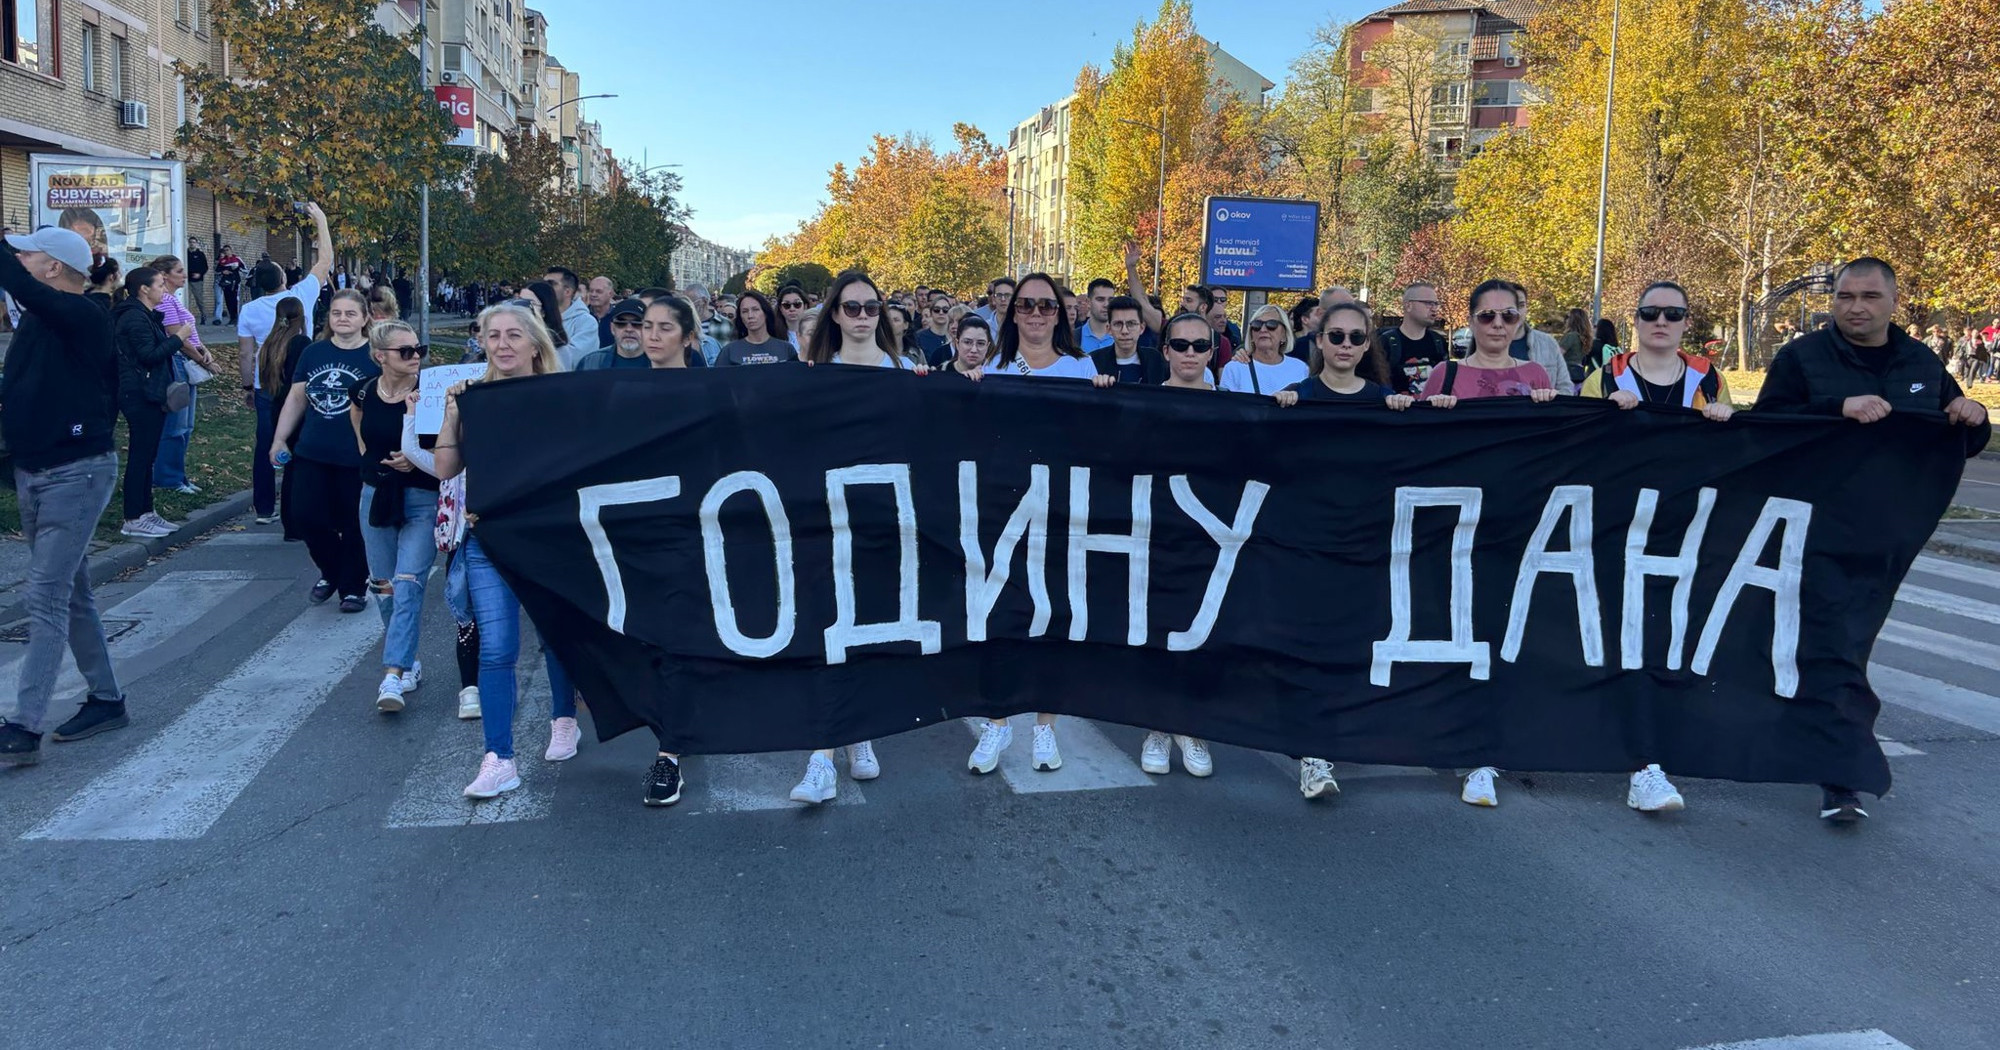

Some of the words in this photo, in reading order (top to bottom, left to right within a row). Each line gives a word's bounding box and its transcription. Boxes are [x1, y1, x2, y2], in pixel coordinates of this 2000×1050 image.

[90, 177, 119, 187] SAD
[50, 189, 142, 199] SUBVENCIJE
[1230, 211, 1251, 219] okov
[1213, 266, 1245, 277] slavu
[445, 368, 459, 377] ЈА
[425, 382, 442, 390] ДА
[424, 396, 445, 409] СТ
[577, 461, 1270, 664] ГОДИНУ
[1370, 484, 1813, 698] ДАНА
